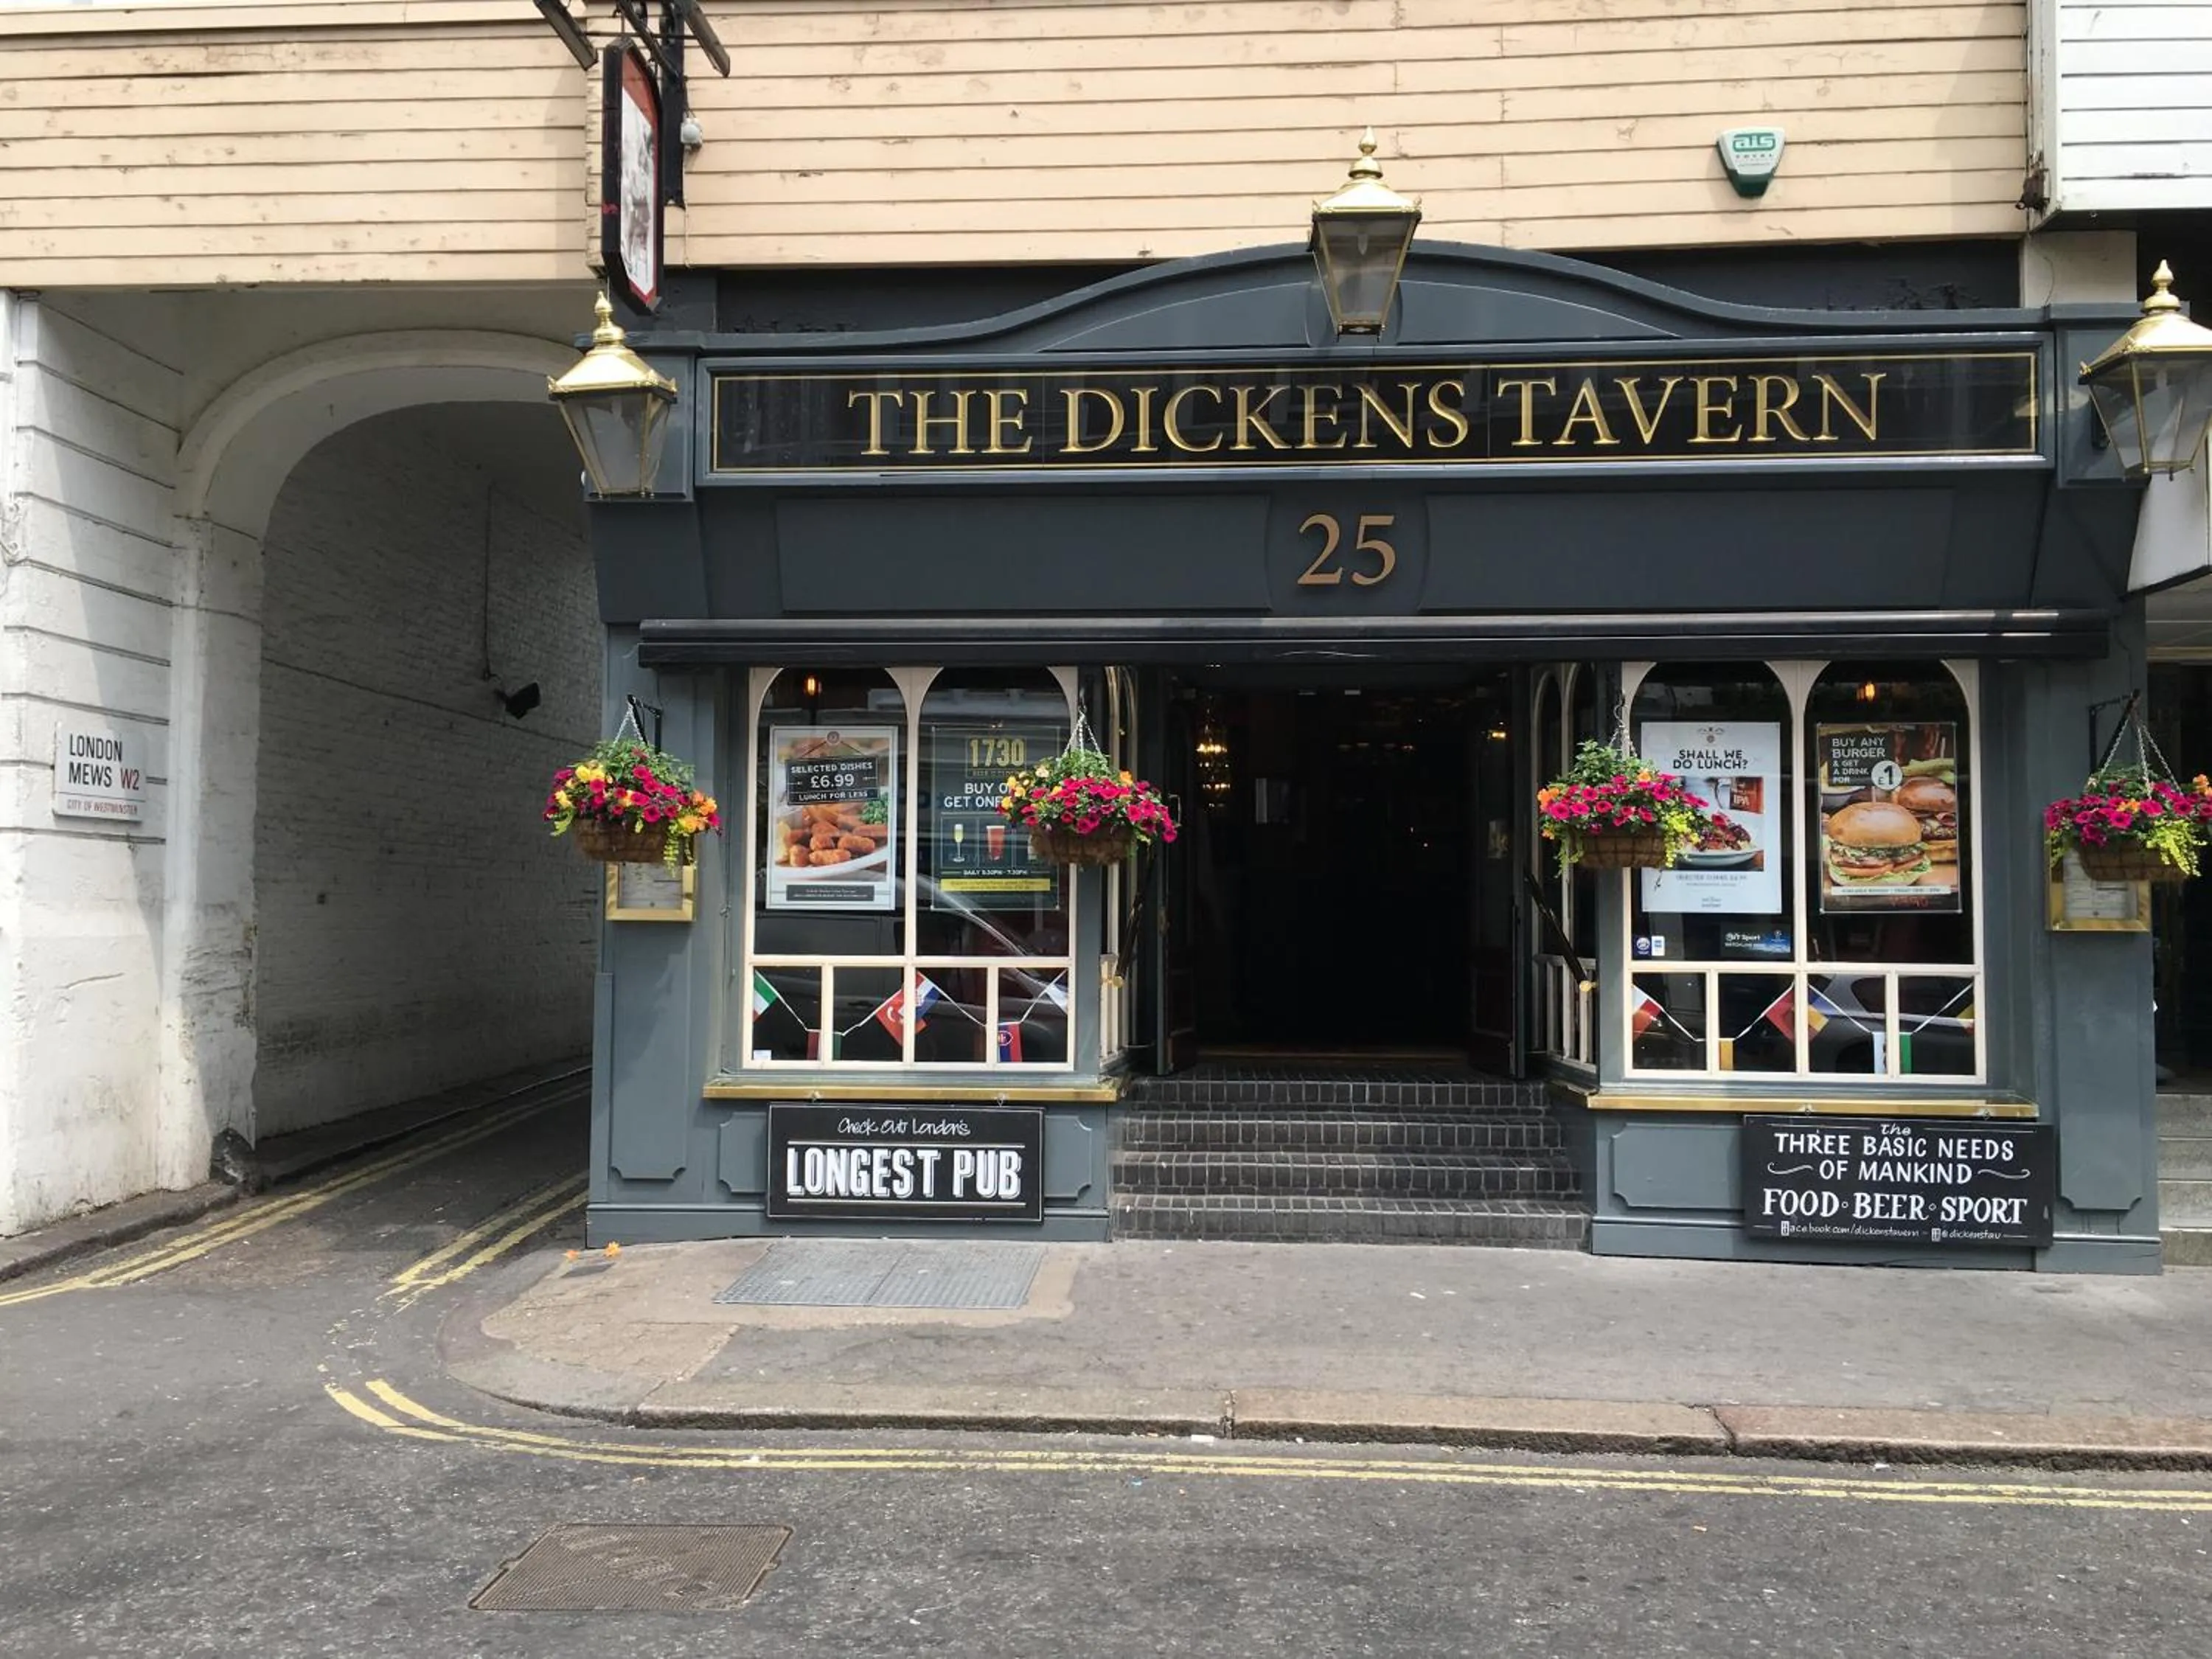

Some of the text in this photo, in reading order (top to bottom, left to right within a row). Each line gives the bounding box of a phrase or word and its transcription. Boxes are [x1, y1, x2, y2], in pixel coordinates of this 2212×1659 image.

[848, 372, 1887, 455] THE DICKENS TAVERN
[1296, 514, 1397, 586] 25
[69, 734, 122, 762] LONDON
[1832, 737, 1885, 747] BUY ANY
[970, 738, 1025, 768] 1730
[1679, 749, 1743, 759] SHALL WE
[1832, 747, 1885, 759] BURGER
[790, 762, 872, 773] SELECTED DISHES
[1673, 759, 1748, 769] DO LUNCH?
[69, 762, 139, 790] MEWS W2
[810, 773, 855, 789] £6.99
[799, 790, 868, 801] LUNCH FOR LESS
[964, 782, 994, 794] BUY
[67, 799, 138, 815] CITY OF WESTMINSTER
[944, 796, 970, 808] GET
[838, 1117, 879, 1136] Check
[1774, 1133, 2014, 1162] THREE BASIC NEEDS
[787, 1147, 1023, 1200] LONGEST PUB
[1819, 1159, 1972, 1185] OF MANKIND
[1762, 1188, 2028, 1225] FOOD BEER SPORT
